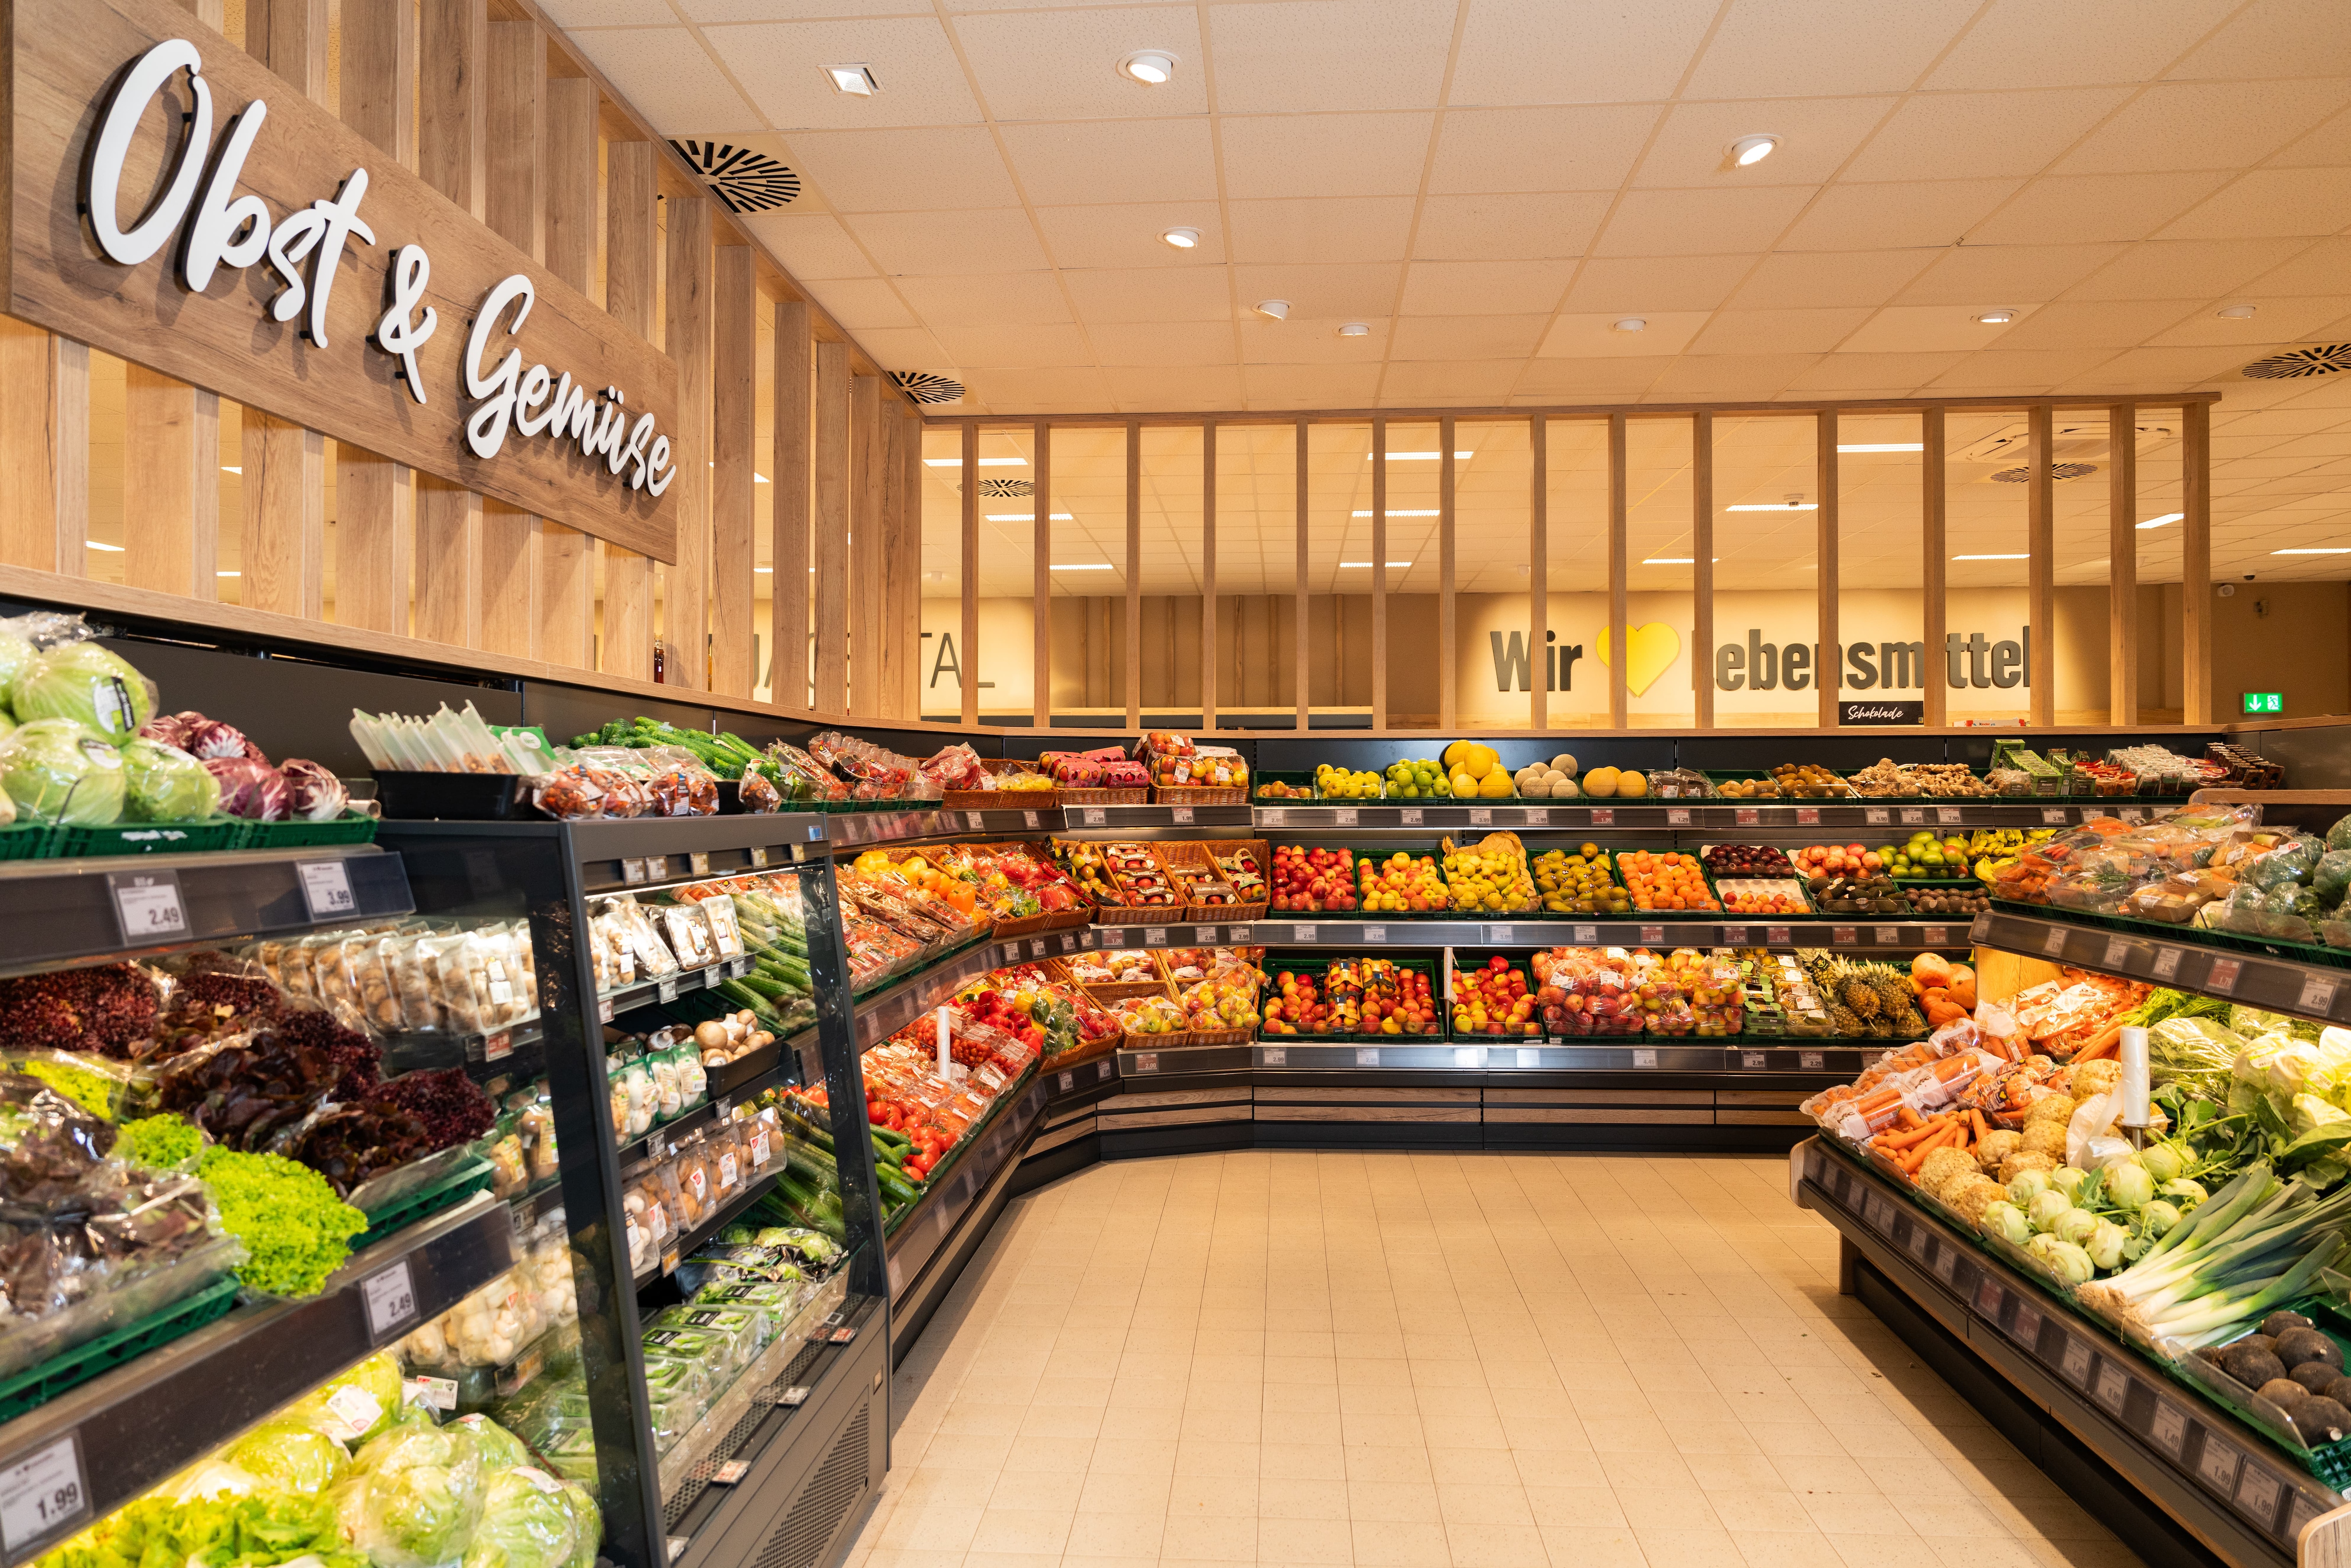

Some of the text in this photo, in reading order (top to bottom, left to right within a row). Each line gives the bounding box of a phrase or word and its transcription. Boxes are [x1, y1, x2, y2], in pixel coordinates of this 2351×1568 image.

[86, 39, 676, 497] Obst & Gemüse
[1490, 630, 1583, 692] Wir
[1848, 705, 1904, 720] Schokolade
[328, 890, 351, 906] 3.99
[148, 907, 180, 926] 2.49
[2311, 995, 2328, 1006] 2.99
[389, 1293, 411, 1318] 2.49
[2214, 1465, 2231, 1486] 1.99
[36, 1481, 79, 1521] 1.99
[2254, 1495, 2272, 1517] 1.99
